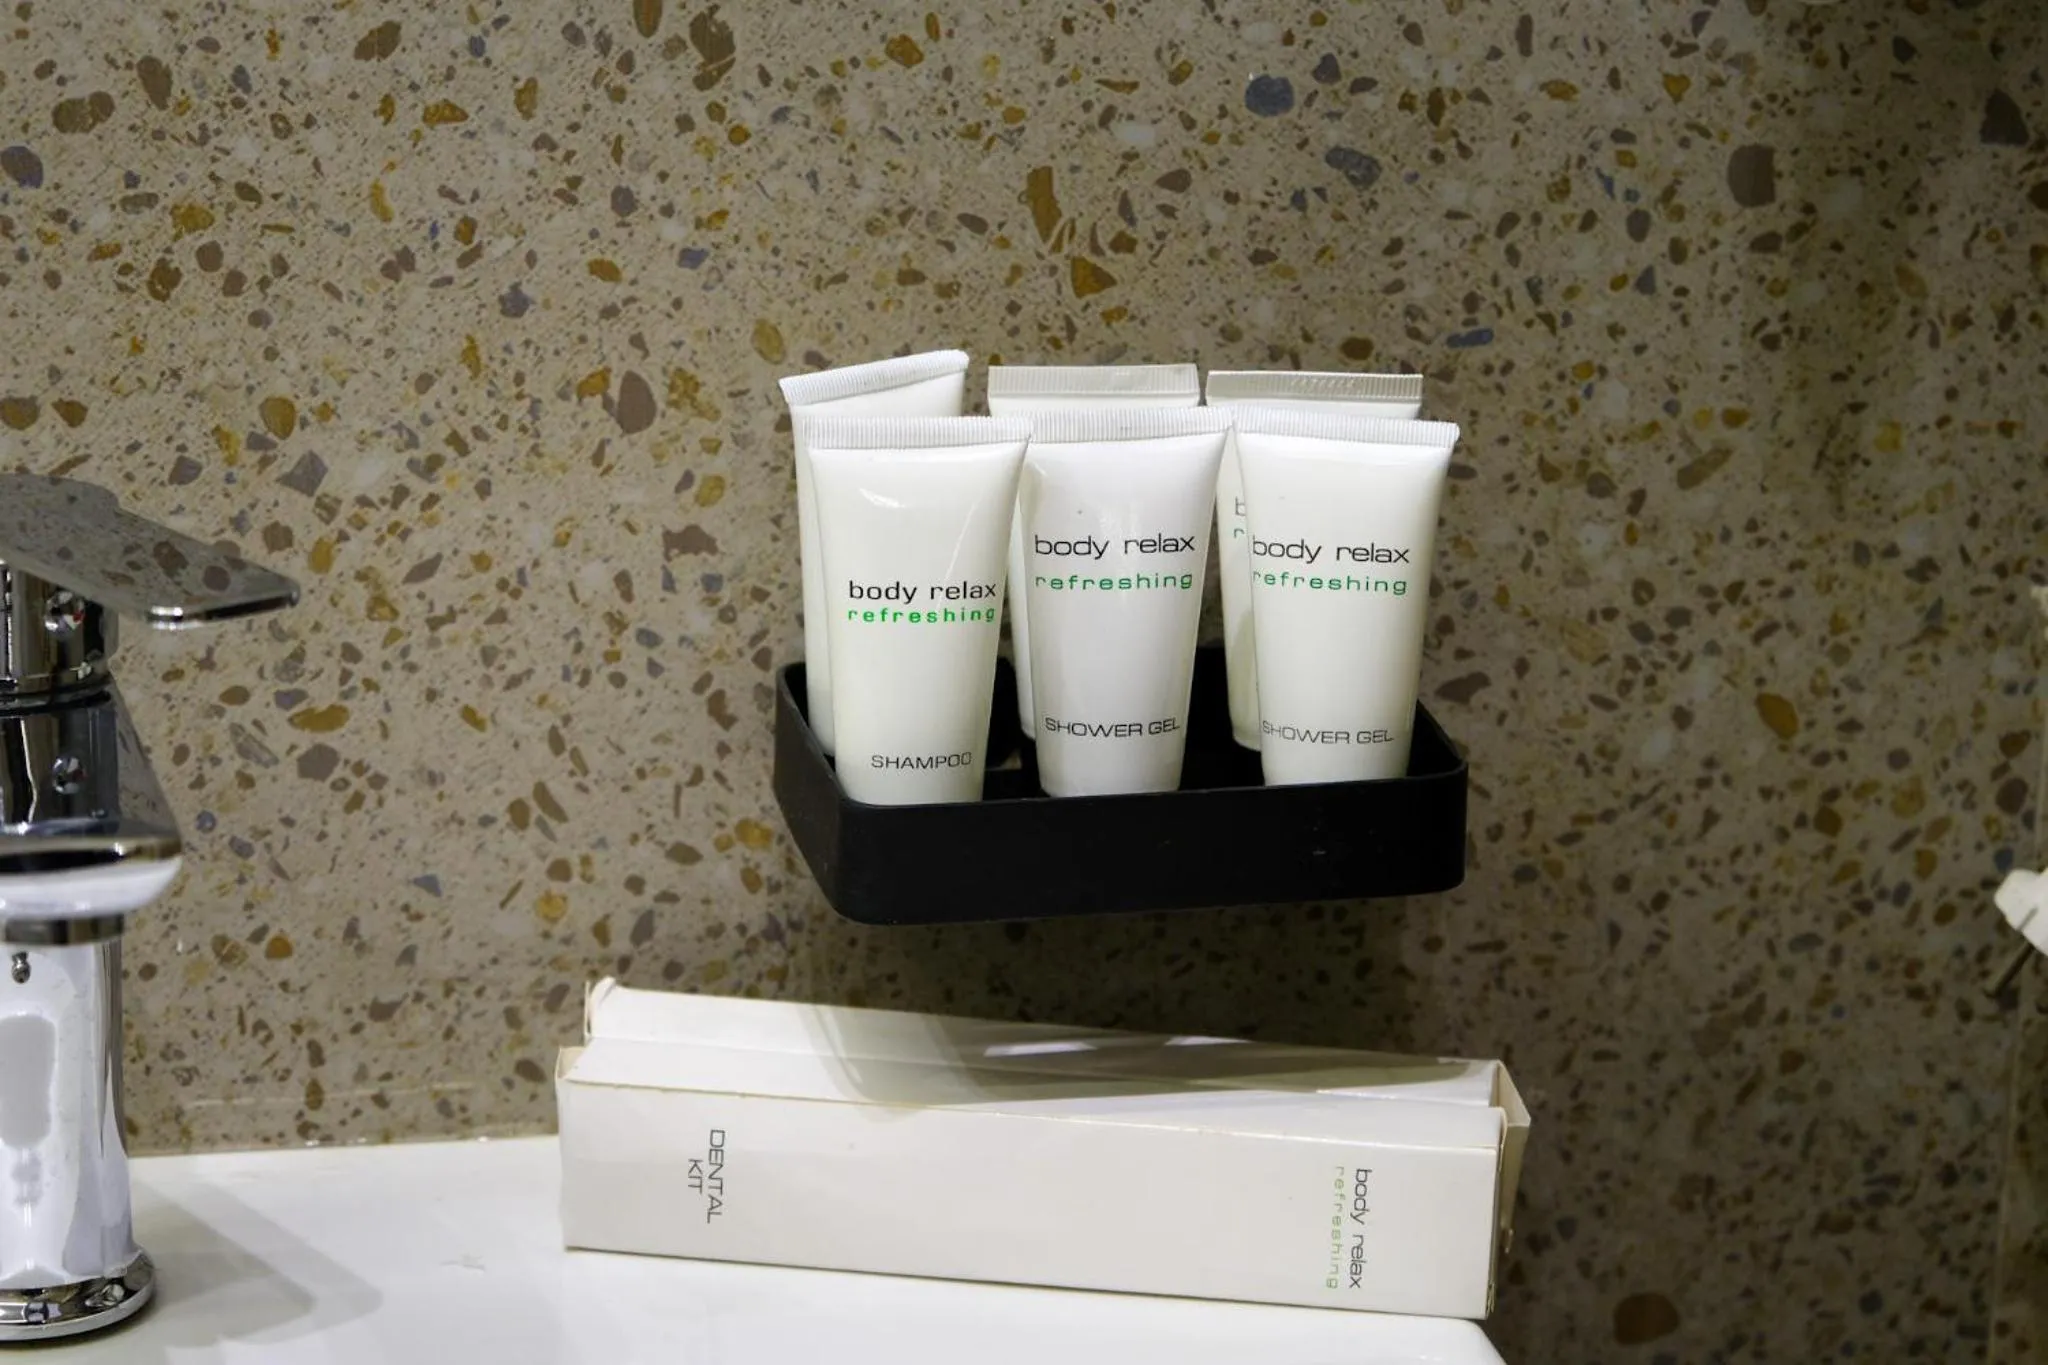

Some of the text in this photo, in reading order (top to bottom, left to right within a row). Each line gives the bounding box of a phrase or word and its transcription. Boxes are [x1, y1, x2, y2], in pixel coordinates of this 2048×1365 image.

[1034, 532, 1196, 561] body relax
[1252, 534, 1411, 565] body relax
[848, 579, 997, 605] body relax
[1034, 572, 1193, 591] refreshing
[1252, 570, 1408, 596] refreshing
[847, 607, 996, 624] refreshing
[1044, 716, 1181, 738] SHOWER GEL
[1261, 719, 1395, 745] SHOWER GEL
[870, 751, 973, 770] SHAMPOO
[687, 1158, 704, 1196] KIT
[706, 1128, 726, 1225] DENTAL
[1325, 1165, 1347, 1290] refreshing
[1348, 1167, 1373, 1289] body relax
